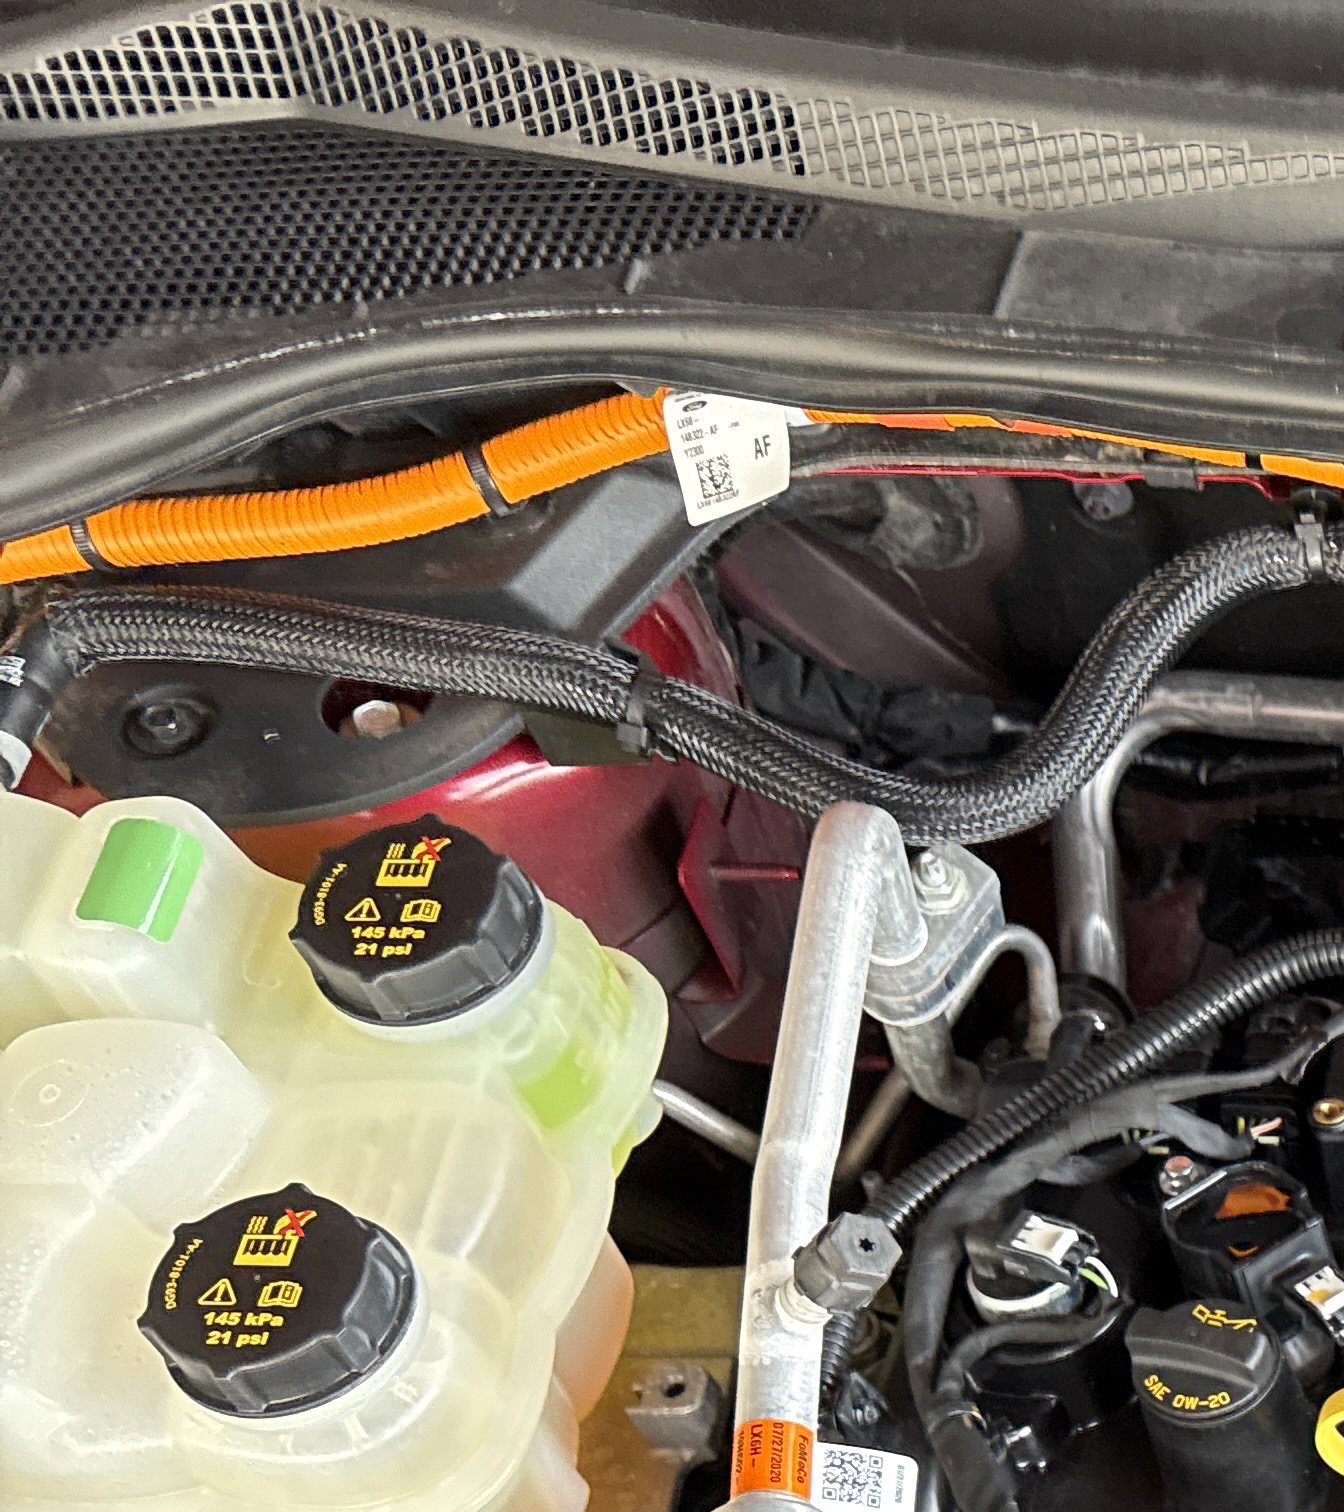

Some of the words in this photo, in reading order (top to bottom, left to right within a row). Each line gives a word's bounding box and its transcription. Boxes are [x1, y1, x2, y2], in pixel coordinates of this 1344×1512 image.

[754, 434, 771, 460] AF
[351, 926, 386, 939] 145
[388, 926, 426, 939] kPa
[353, 942, 378, 956] 21
[381, 942, 413, 958] psi
[203, 1311, 242, 1326] 145
[243, 1312, 285, 1327] kPa
[205, 1330, 232, 1345] 21
[235, 1331, 270, 1348] psi
[1143, 1374, 1171, 1401] SAE
[1172, 1391, 1231, 1410] 0W-20
[770, 1422, 785, 1484] 07/27/2020
[796, 1434, 809, 1484] FoMoCo
